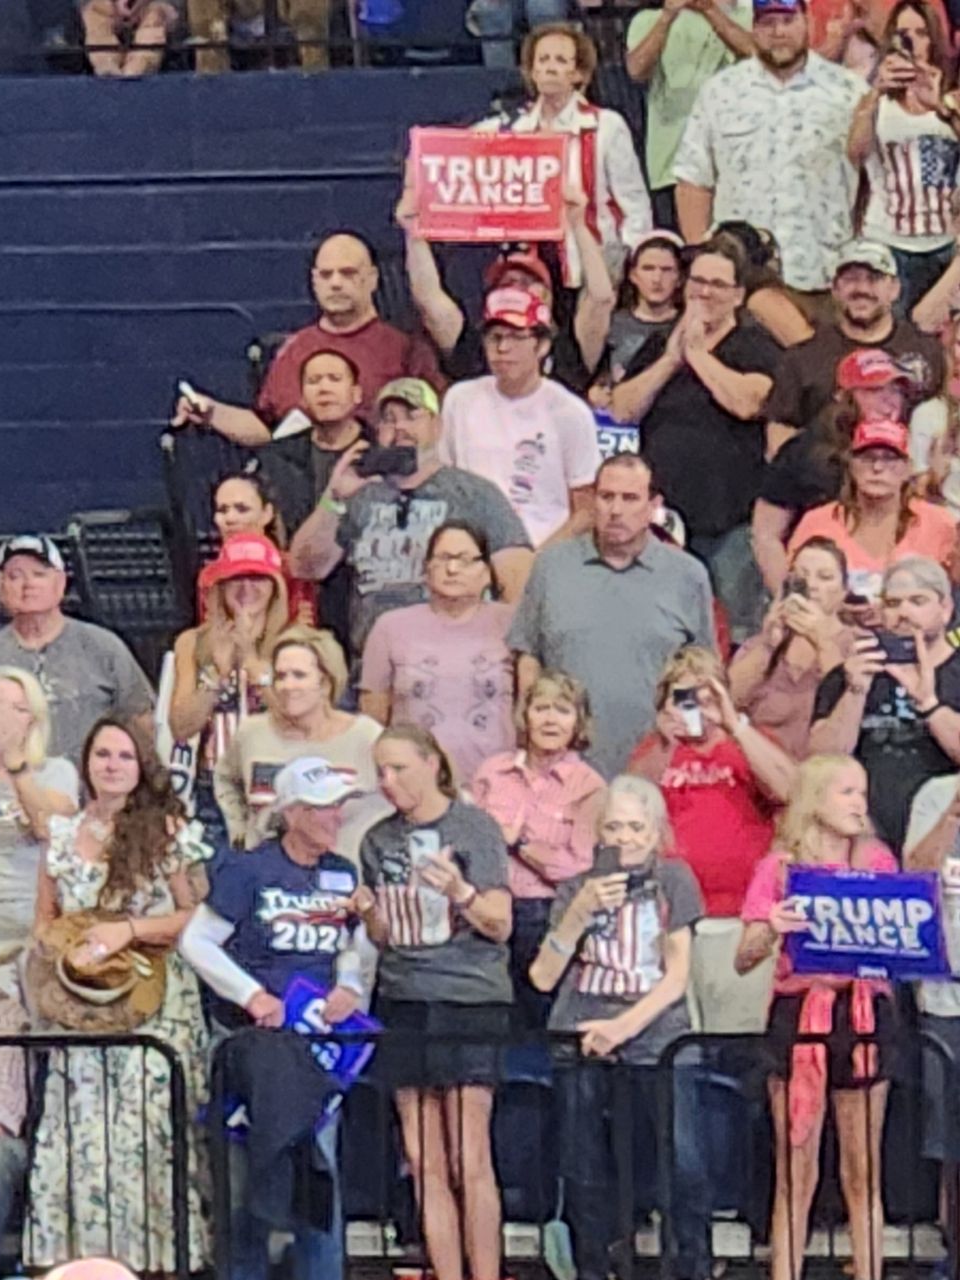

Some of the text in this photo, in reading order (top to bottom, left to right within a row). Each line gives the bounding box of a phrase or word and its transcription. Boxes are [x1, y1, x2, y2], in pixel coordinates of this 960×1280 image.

[421, 154, 560, 183] TRUMP
[437, 181, 545, 204] VANCE
[808, 919, 922, 949] VANCE
